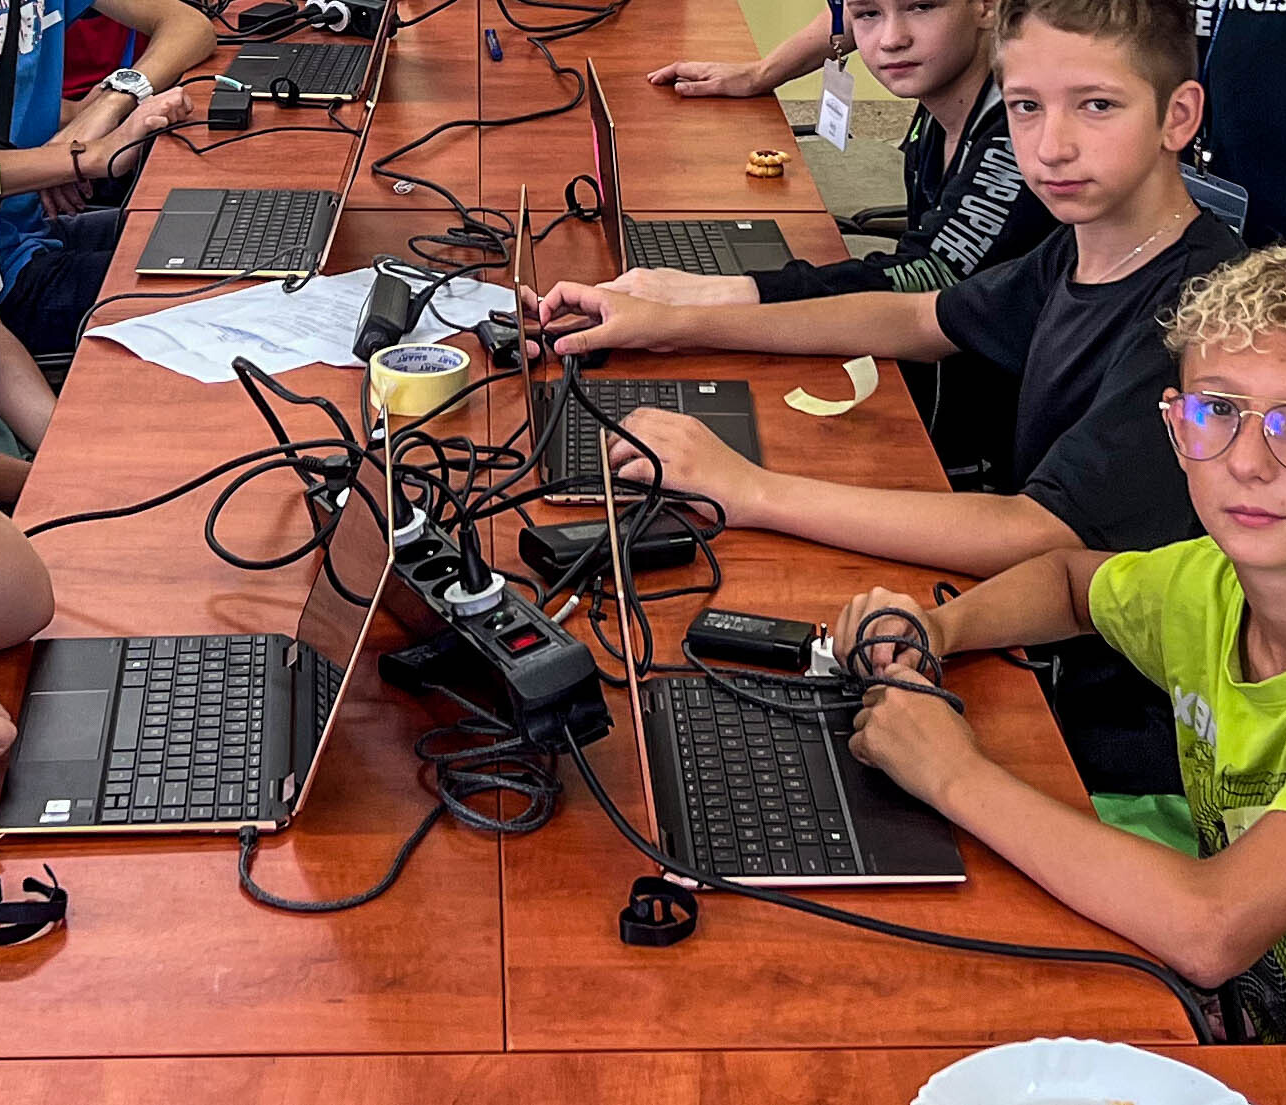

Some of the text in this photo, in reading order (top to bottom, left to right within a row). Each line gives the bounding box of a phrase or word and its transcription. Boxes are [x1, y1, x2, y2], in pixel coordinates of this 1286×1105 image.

[958, 194, 1010, 236] UP
[930, 217, 994, 276] THE
[398, 354, 428, 363] SMART
